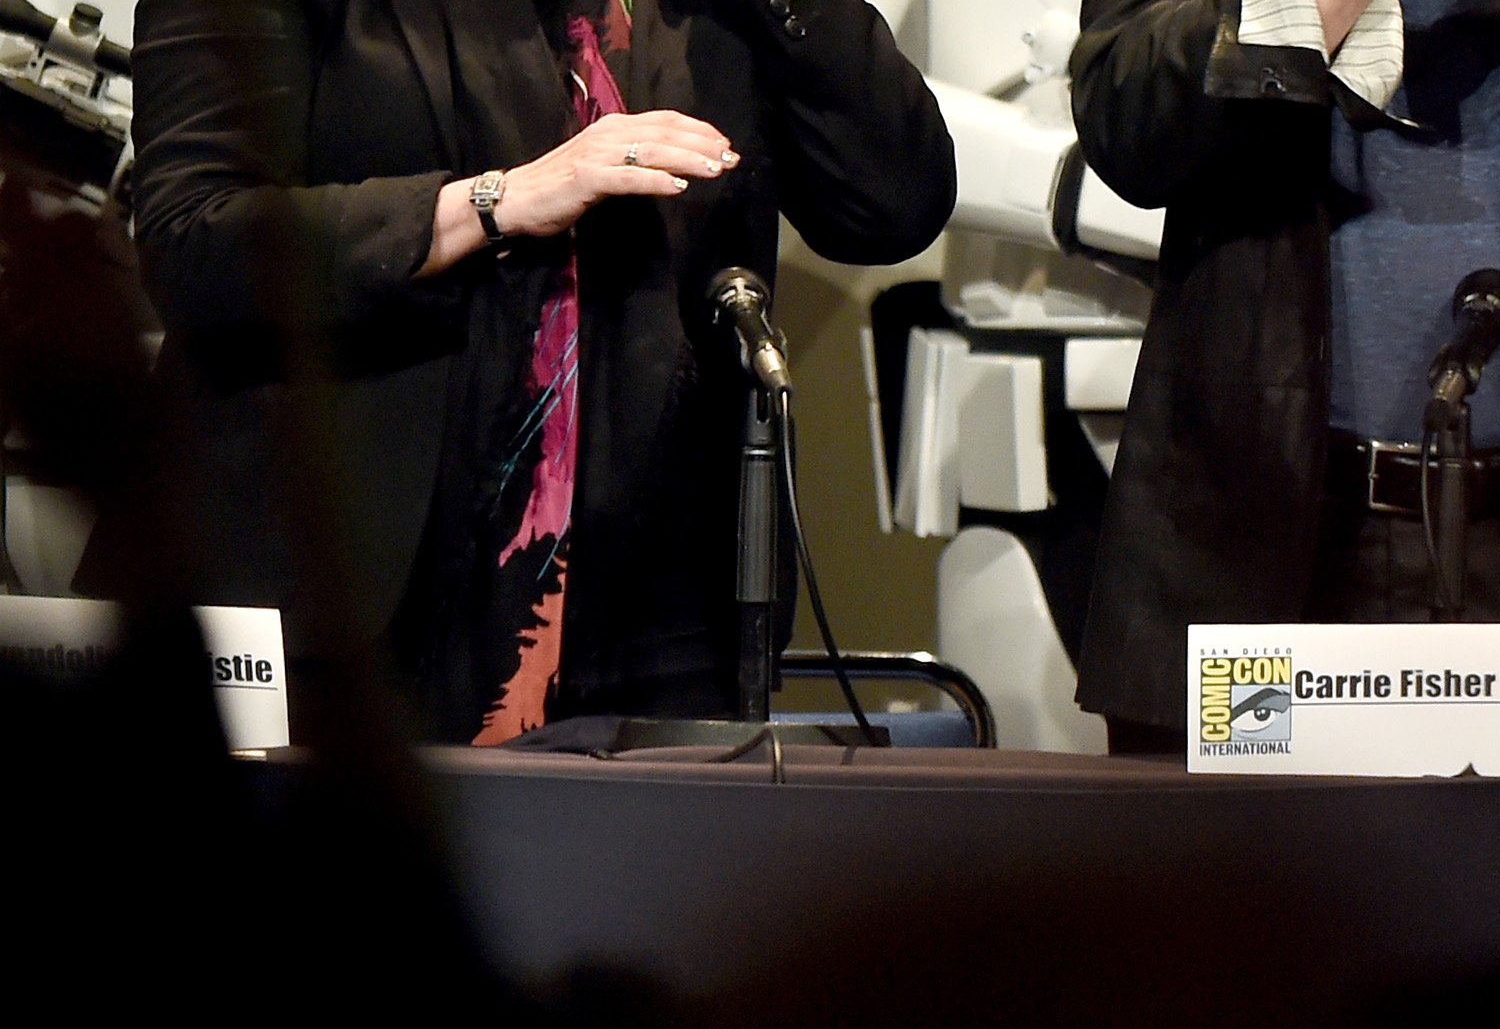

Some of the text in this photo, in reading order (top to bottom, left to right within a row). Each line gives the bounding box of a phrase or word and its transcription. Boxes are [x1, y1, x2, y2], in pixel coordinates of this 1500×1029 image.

[1200, 647, 1292, 656] SAN DIEGO
[205, 653, 273, 682] istie
[1233, 657, 1291, 685] CON
[1295, 669, 1496, 698] Carrie Fisher
[1201, 659, 1231, 742] COMIC
[1200, 742, 1291, 756] INTERNATIONAL
